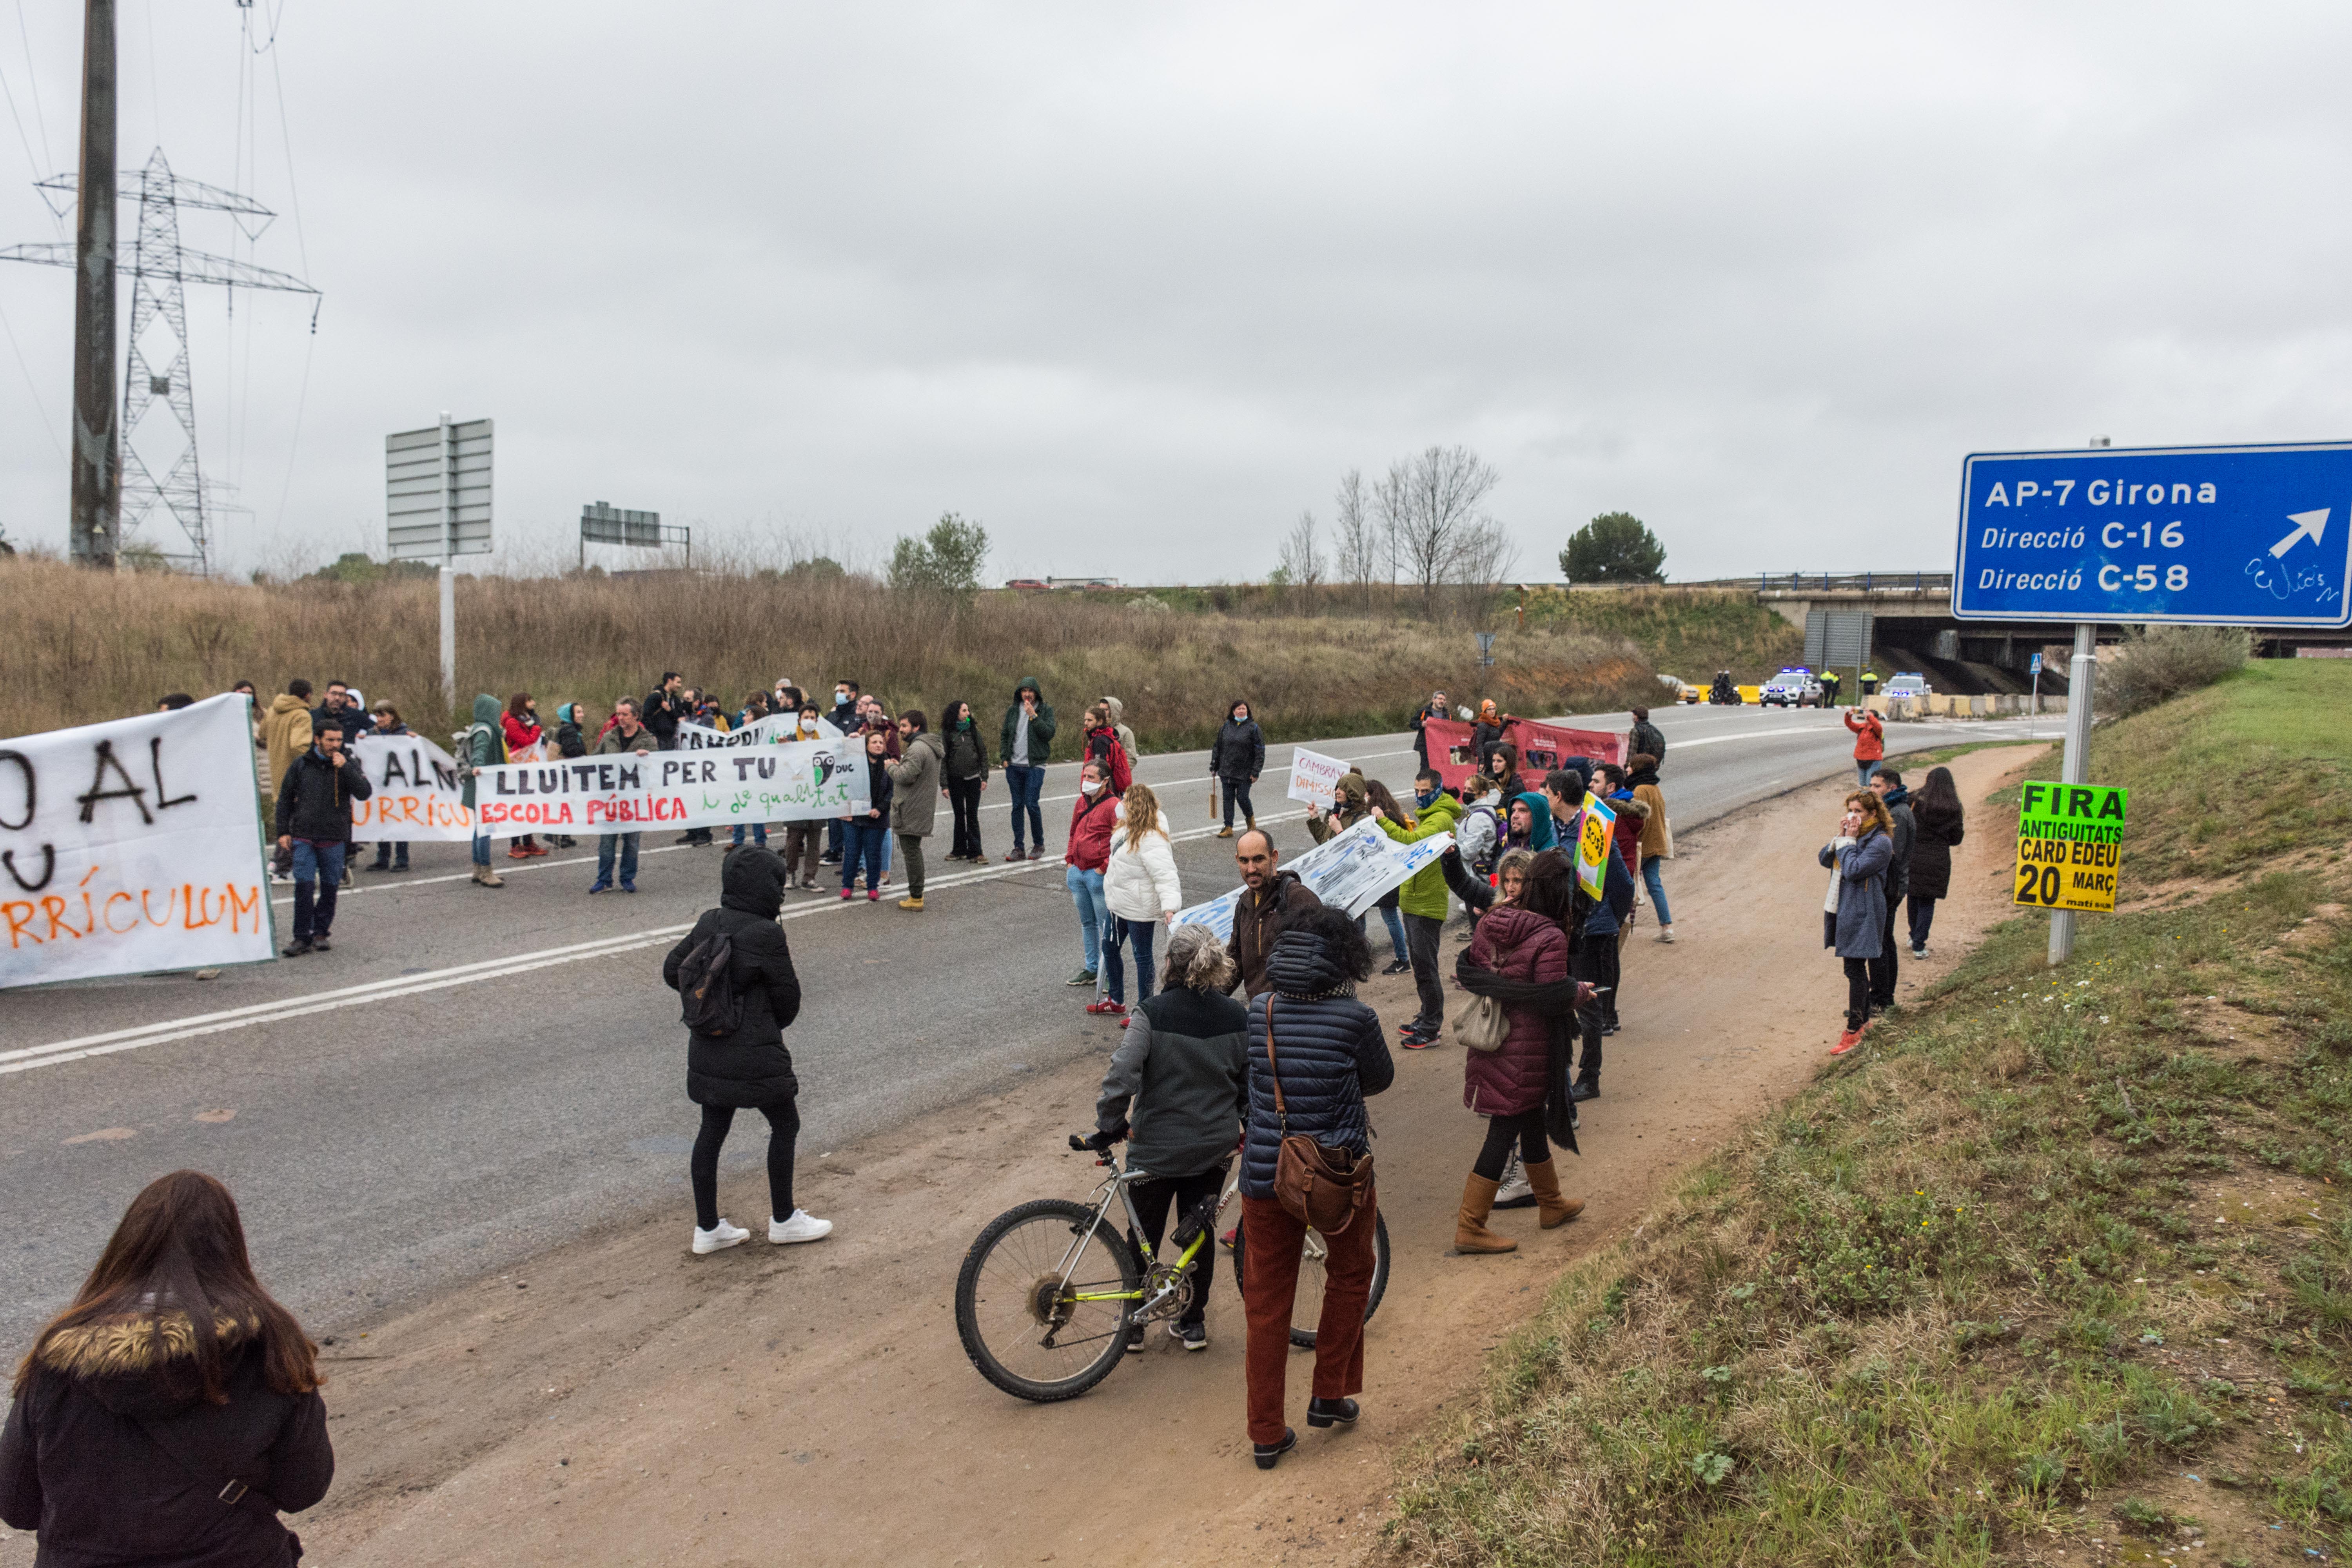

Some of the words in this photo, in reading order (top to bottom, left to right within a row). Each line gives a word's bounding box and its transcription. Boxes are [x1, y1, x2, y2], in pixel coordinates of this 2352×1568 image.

[1984, 479, 2076, 507] AP-7
[2087, 479, 2217, 506] Girona
[1981, 526, 2085, 549] Direcció
[2102, 520, 2185, 549] C-16
[1978, 568, 2082, 590] Direcció
[2098, 564, 2189, 592] C-58
[76, 737, 197, 824] AL
[663, 760, 717, 786] PER
[733, 757, 776, 781] TU
[481, 802, 573, 824] ESCOLA
[731, 789, 752, 814] de
[759, 782, 849, 816] qualitat
[2023, 785, 2124, 820] FIRA
[1586, 826, 1599, 850] SOS
[2019, 819, 2122, 845] ANTIGUITATS
[2016, 864, 2061, 906] 20
[2073, 871, 2114, 897] MARÇ
